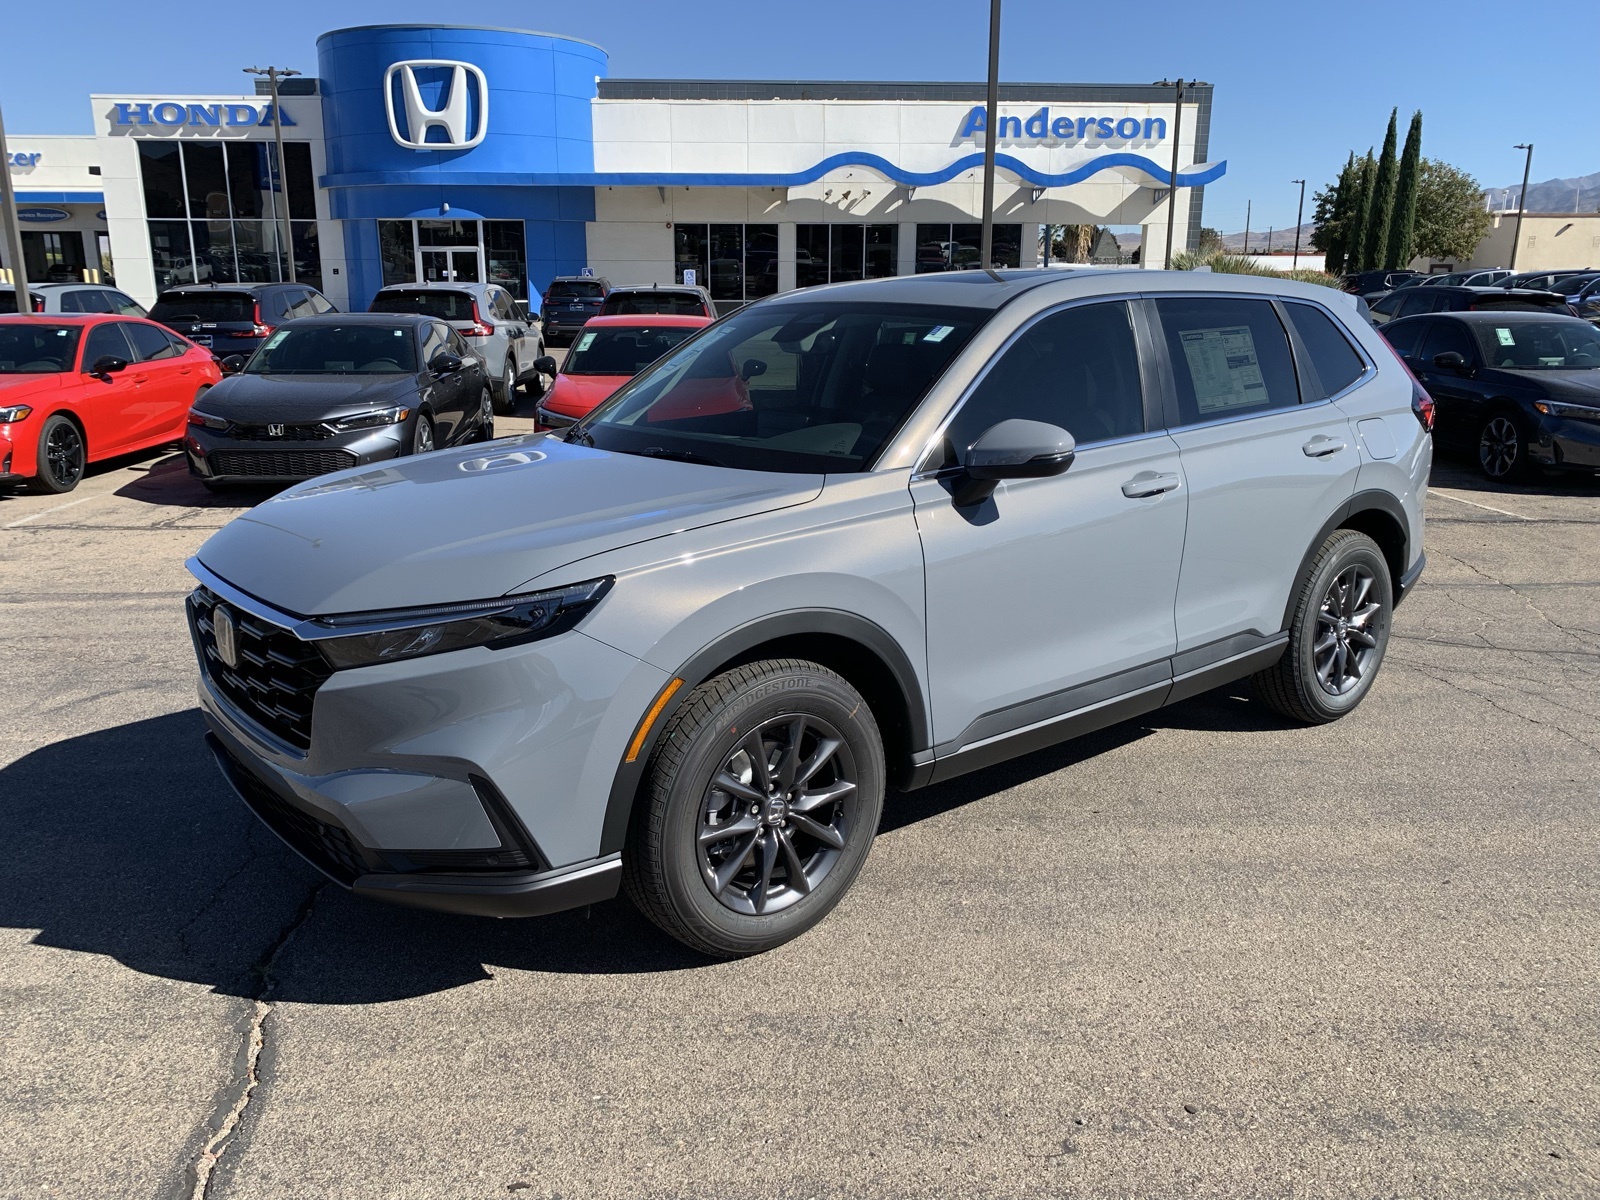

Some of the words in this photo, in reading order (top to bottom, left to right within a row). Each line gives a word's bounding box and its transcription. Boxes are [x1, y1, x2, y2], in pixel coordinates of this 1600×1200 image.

[114, 102, 297, 127] HONDA
[961, 105, 1167, 139] Anderson
[720, 678, 813, 726] BRIDGESTONE
